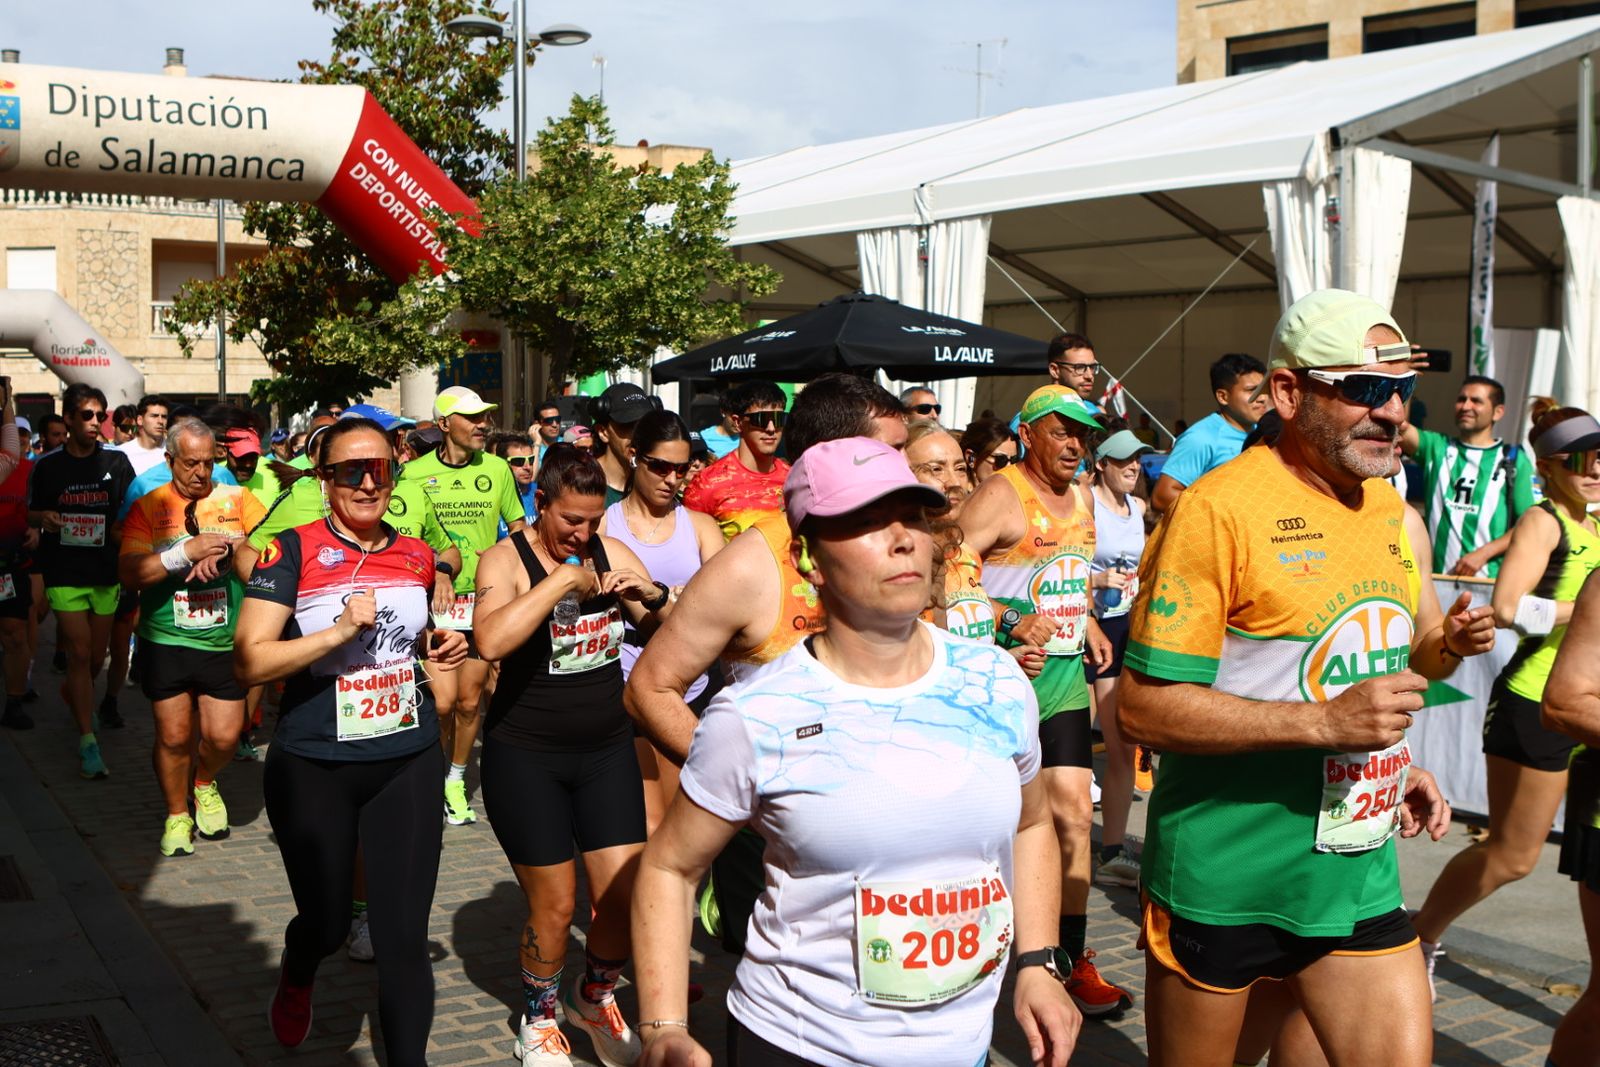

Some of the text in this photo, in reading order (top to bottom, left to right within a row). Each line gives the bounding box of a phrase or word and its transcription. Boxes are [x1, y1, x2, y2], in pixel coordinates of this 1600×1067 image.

[48, 83, 268, 130] Diputación
[44, 136, 305, 182] de Salamanca
[363, 139, 400, 177] CON
[349, 161, 449, 262] DEPORTISTAS
[710, 353, 756, 373] LA SALVE
[934, 346, 994, 364] LA SALVE
[432, 501, 493, 510] ORRECAMINOS
[438, 510, 485, 518] ARBAJOSA
[72, 526, 94, 537] 251
[1037, 577, 1087, 596] ALCER
[1306, 592, 1346, 634] CLUB
[575, 633, 609, 657] 188
[338, 668, 414, 692] bedunia
[360, 692, 400, 719] 268
[1352, 783, 1398, 821] 250
[861, 877, 1007, 917] bedunia
[902, 923, 980, 969] 208
